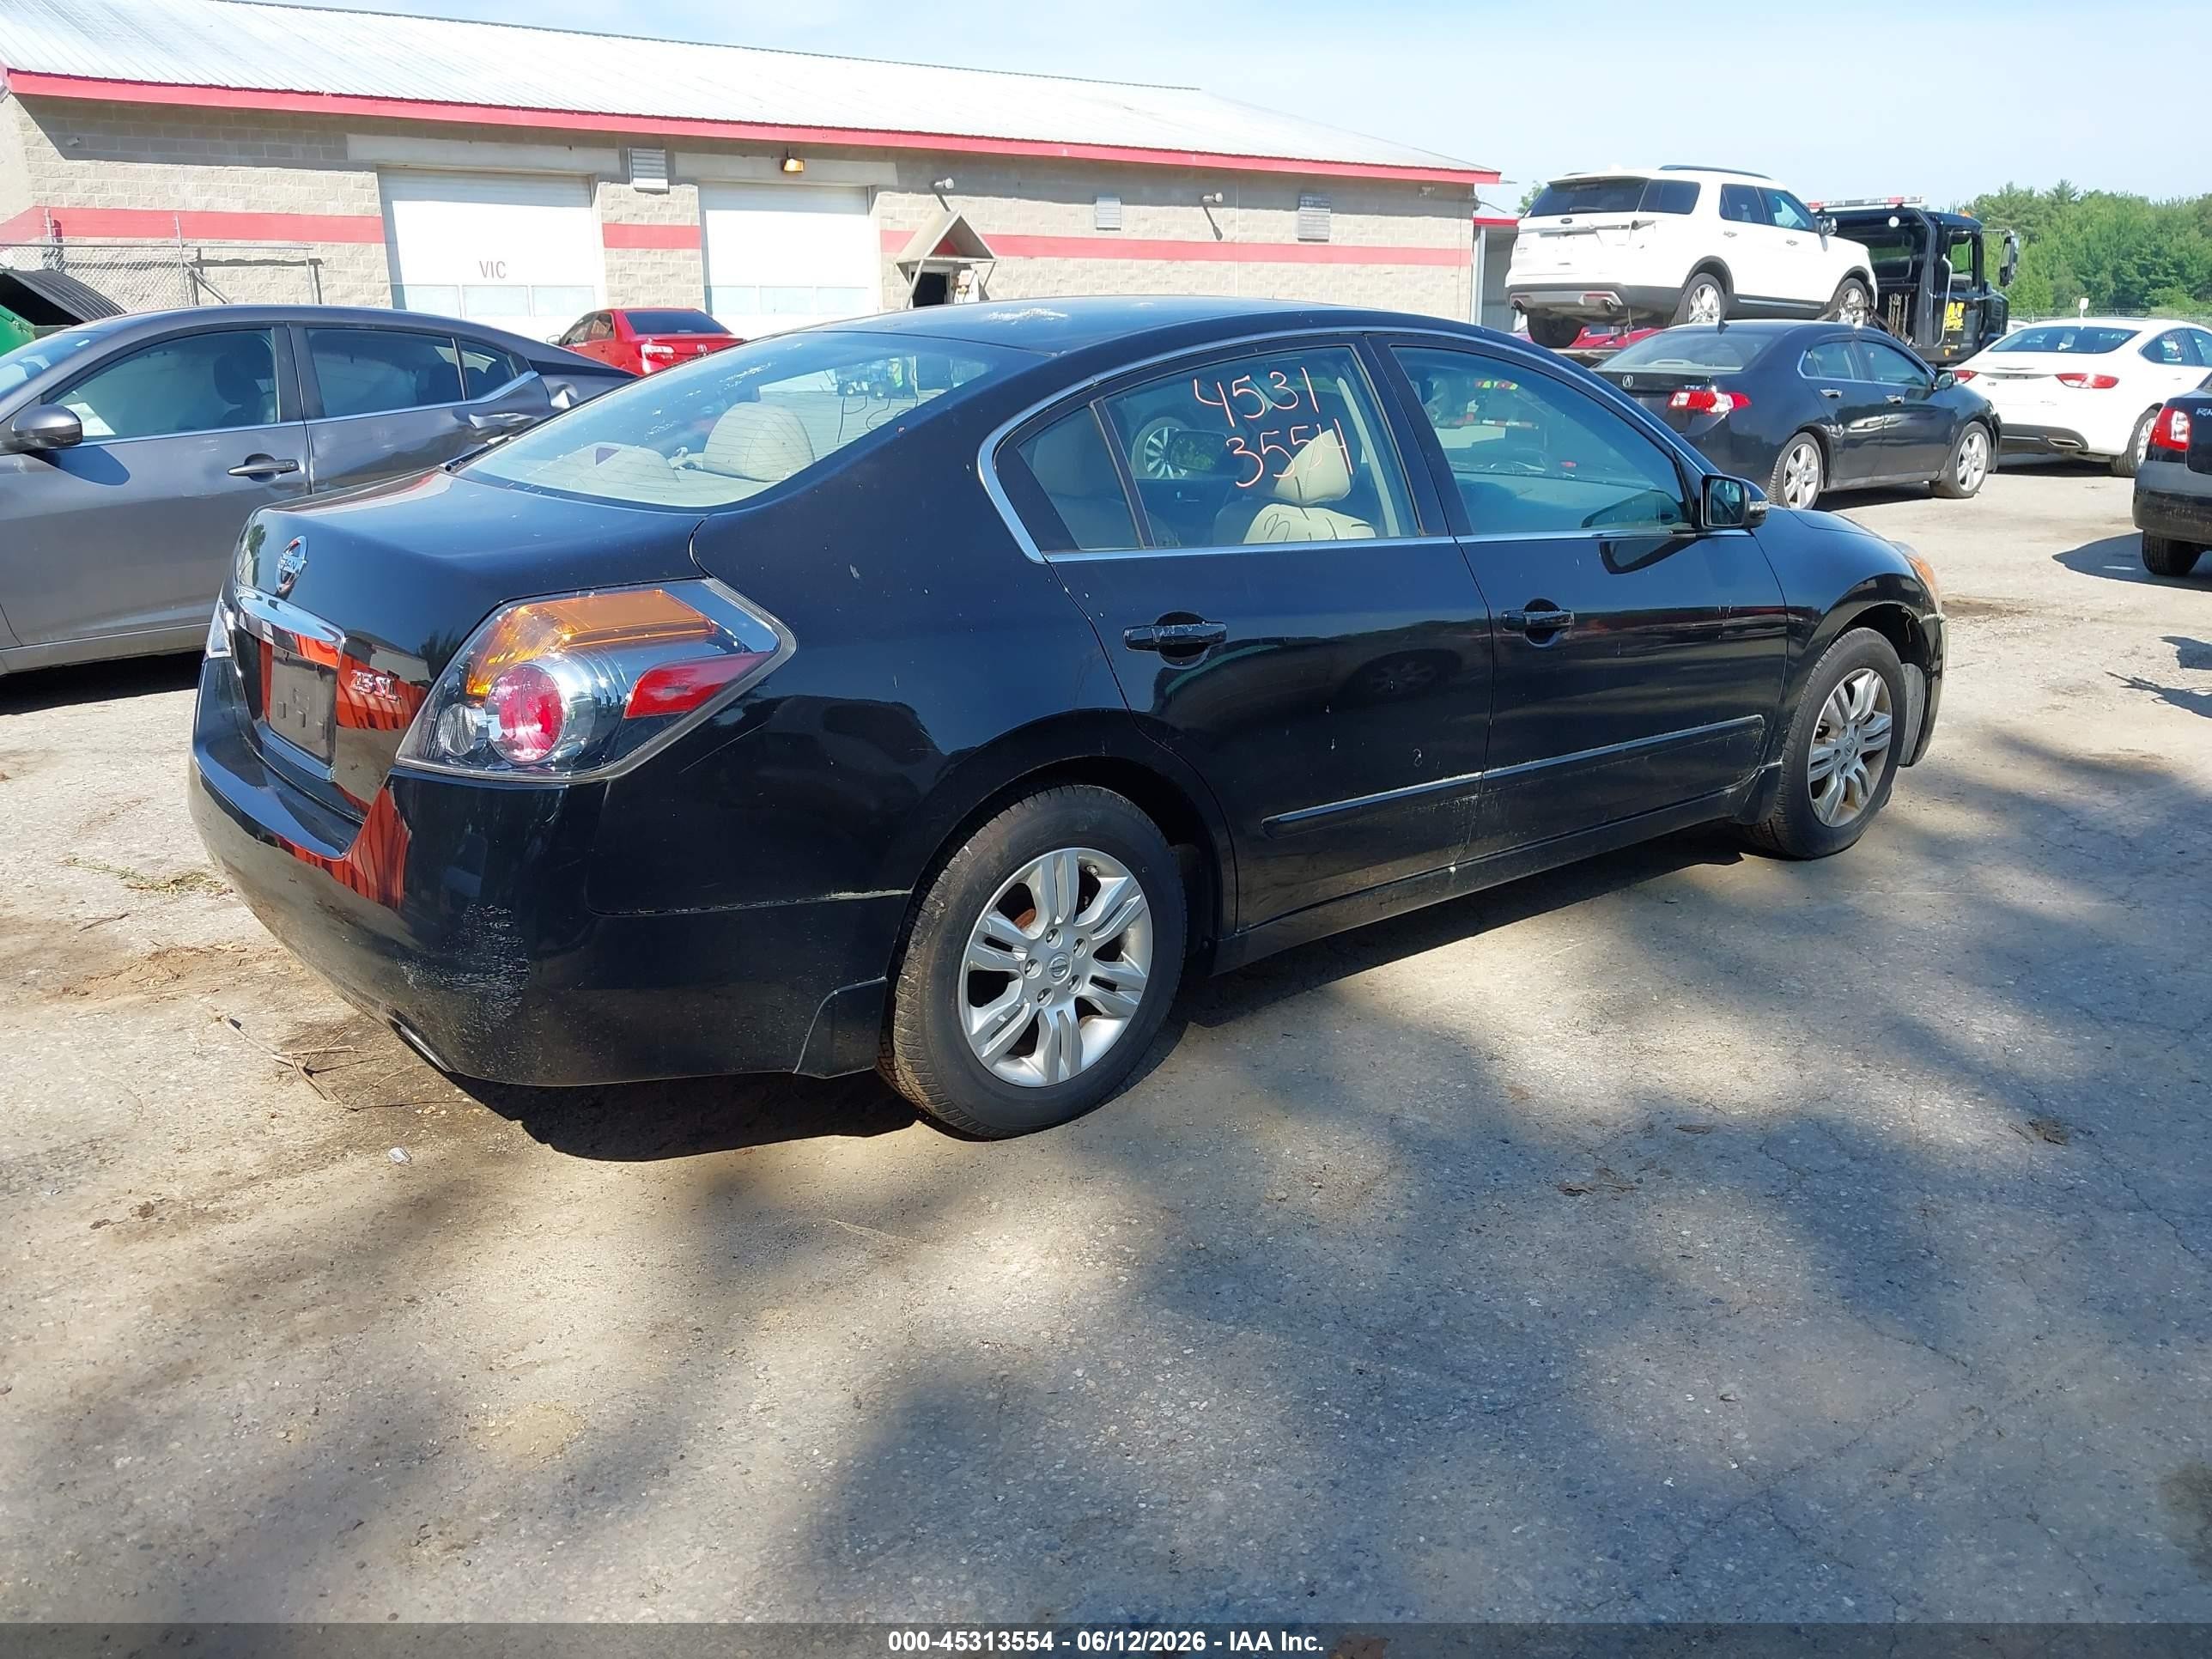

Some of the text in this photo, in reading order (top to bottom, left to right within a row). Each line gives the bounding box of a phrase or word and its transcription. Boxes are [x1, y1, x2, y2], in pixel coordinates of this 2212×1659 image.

[479, 260, 507, 279] VIC
[1194, 367, 1319, 427] 4531
[1226, 418, 1353, 487] 3554
